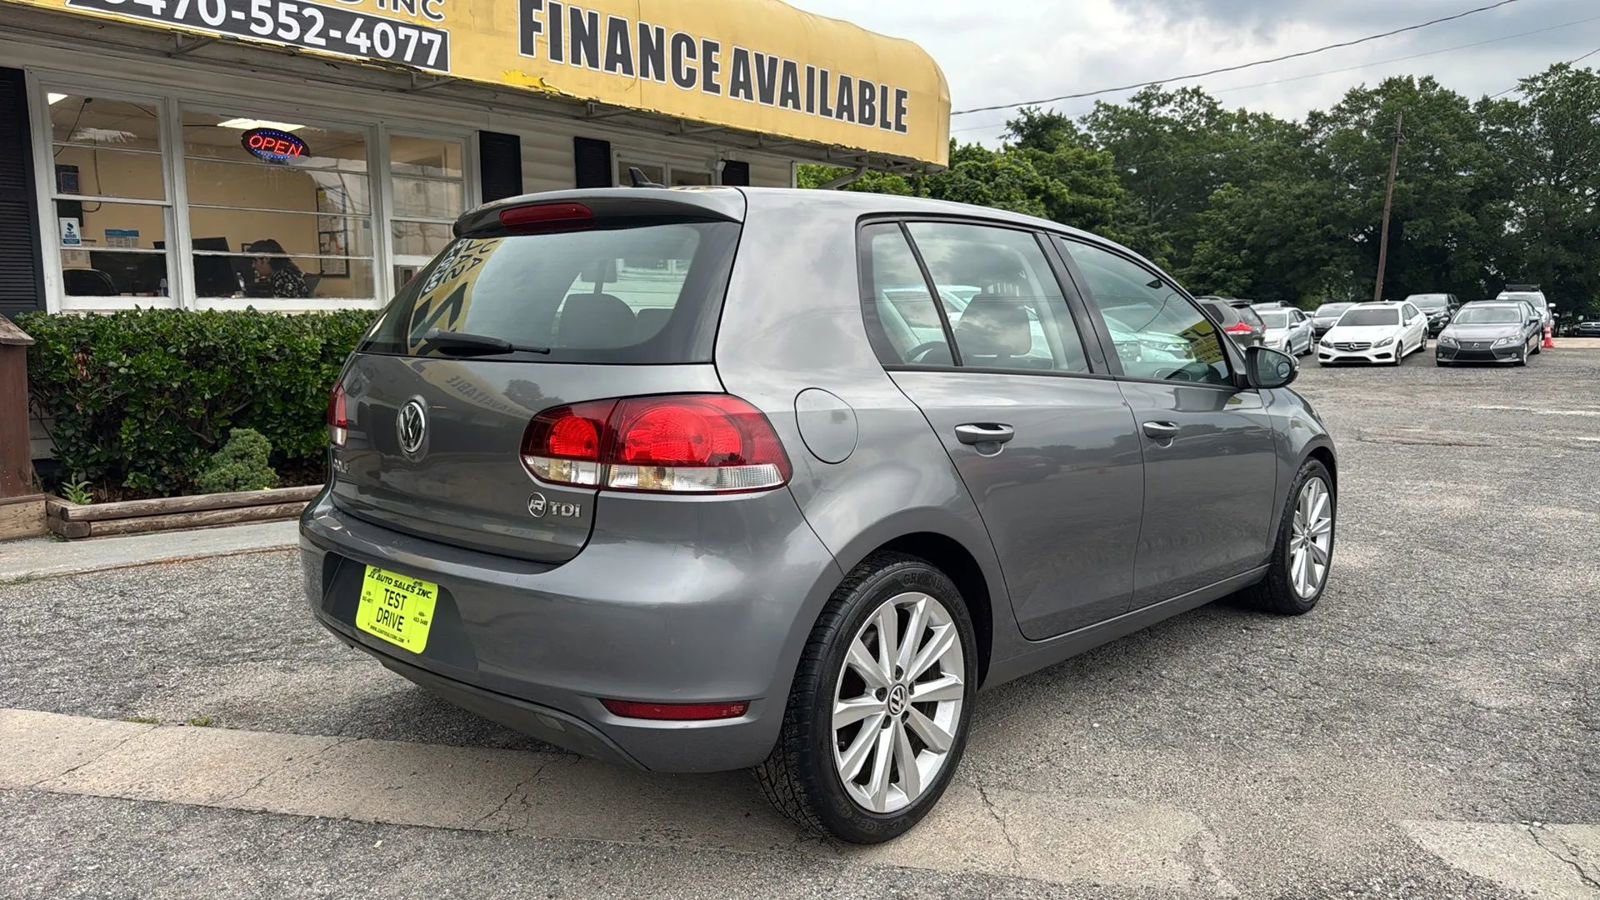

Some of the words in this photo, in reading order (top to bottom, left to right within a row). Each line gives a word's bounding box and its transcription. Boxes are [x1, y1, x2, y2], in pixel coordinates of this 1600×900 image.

[518, 0, 721, 95] FINANCE
[729, 47, 908, 133] AVAILABLE
[249, 135, 303, 157] OPEN
[376, 573, 393, 585] AUTO
[393, 580, 416, 593] SALES
[385, 588, 407, 611] TEST
[376, 607, 405, 632] DRIVE
